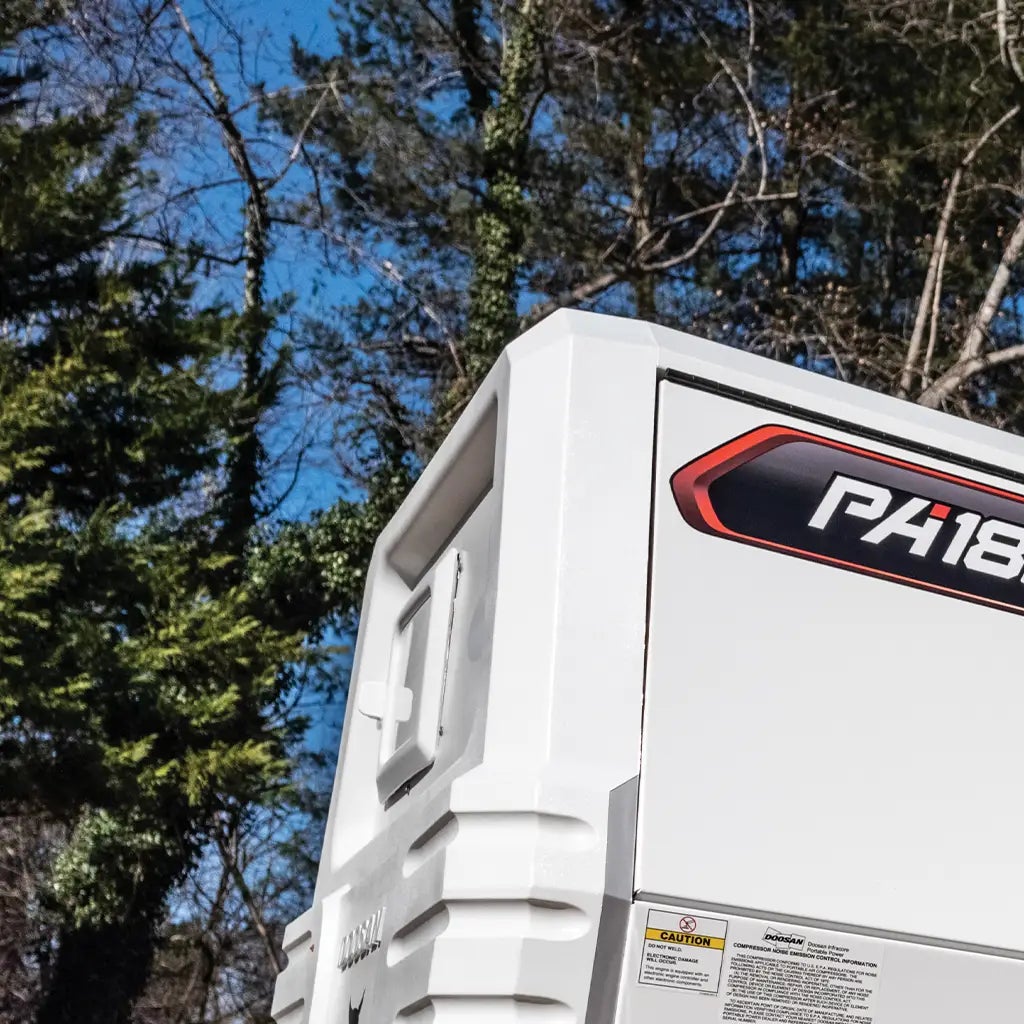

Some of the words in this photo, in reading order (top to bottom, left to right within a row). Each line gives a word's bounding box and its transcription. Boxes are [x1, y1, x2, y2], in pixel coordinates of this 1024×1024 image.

[660, 932, 711, 946] CAUTION
[764, 933, 804, 946] DOOSAN
[647, 953, 677, 961] ELECTRONIC
[733, 943, 772, 953] COMPRESSOR
[790, 951, 815, 959] EMISSION
[816, 955, 841, 963] CONTROL
[842, 959, 878, 968] INFORMATION
